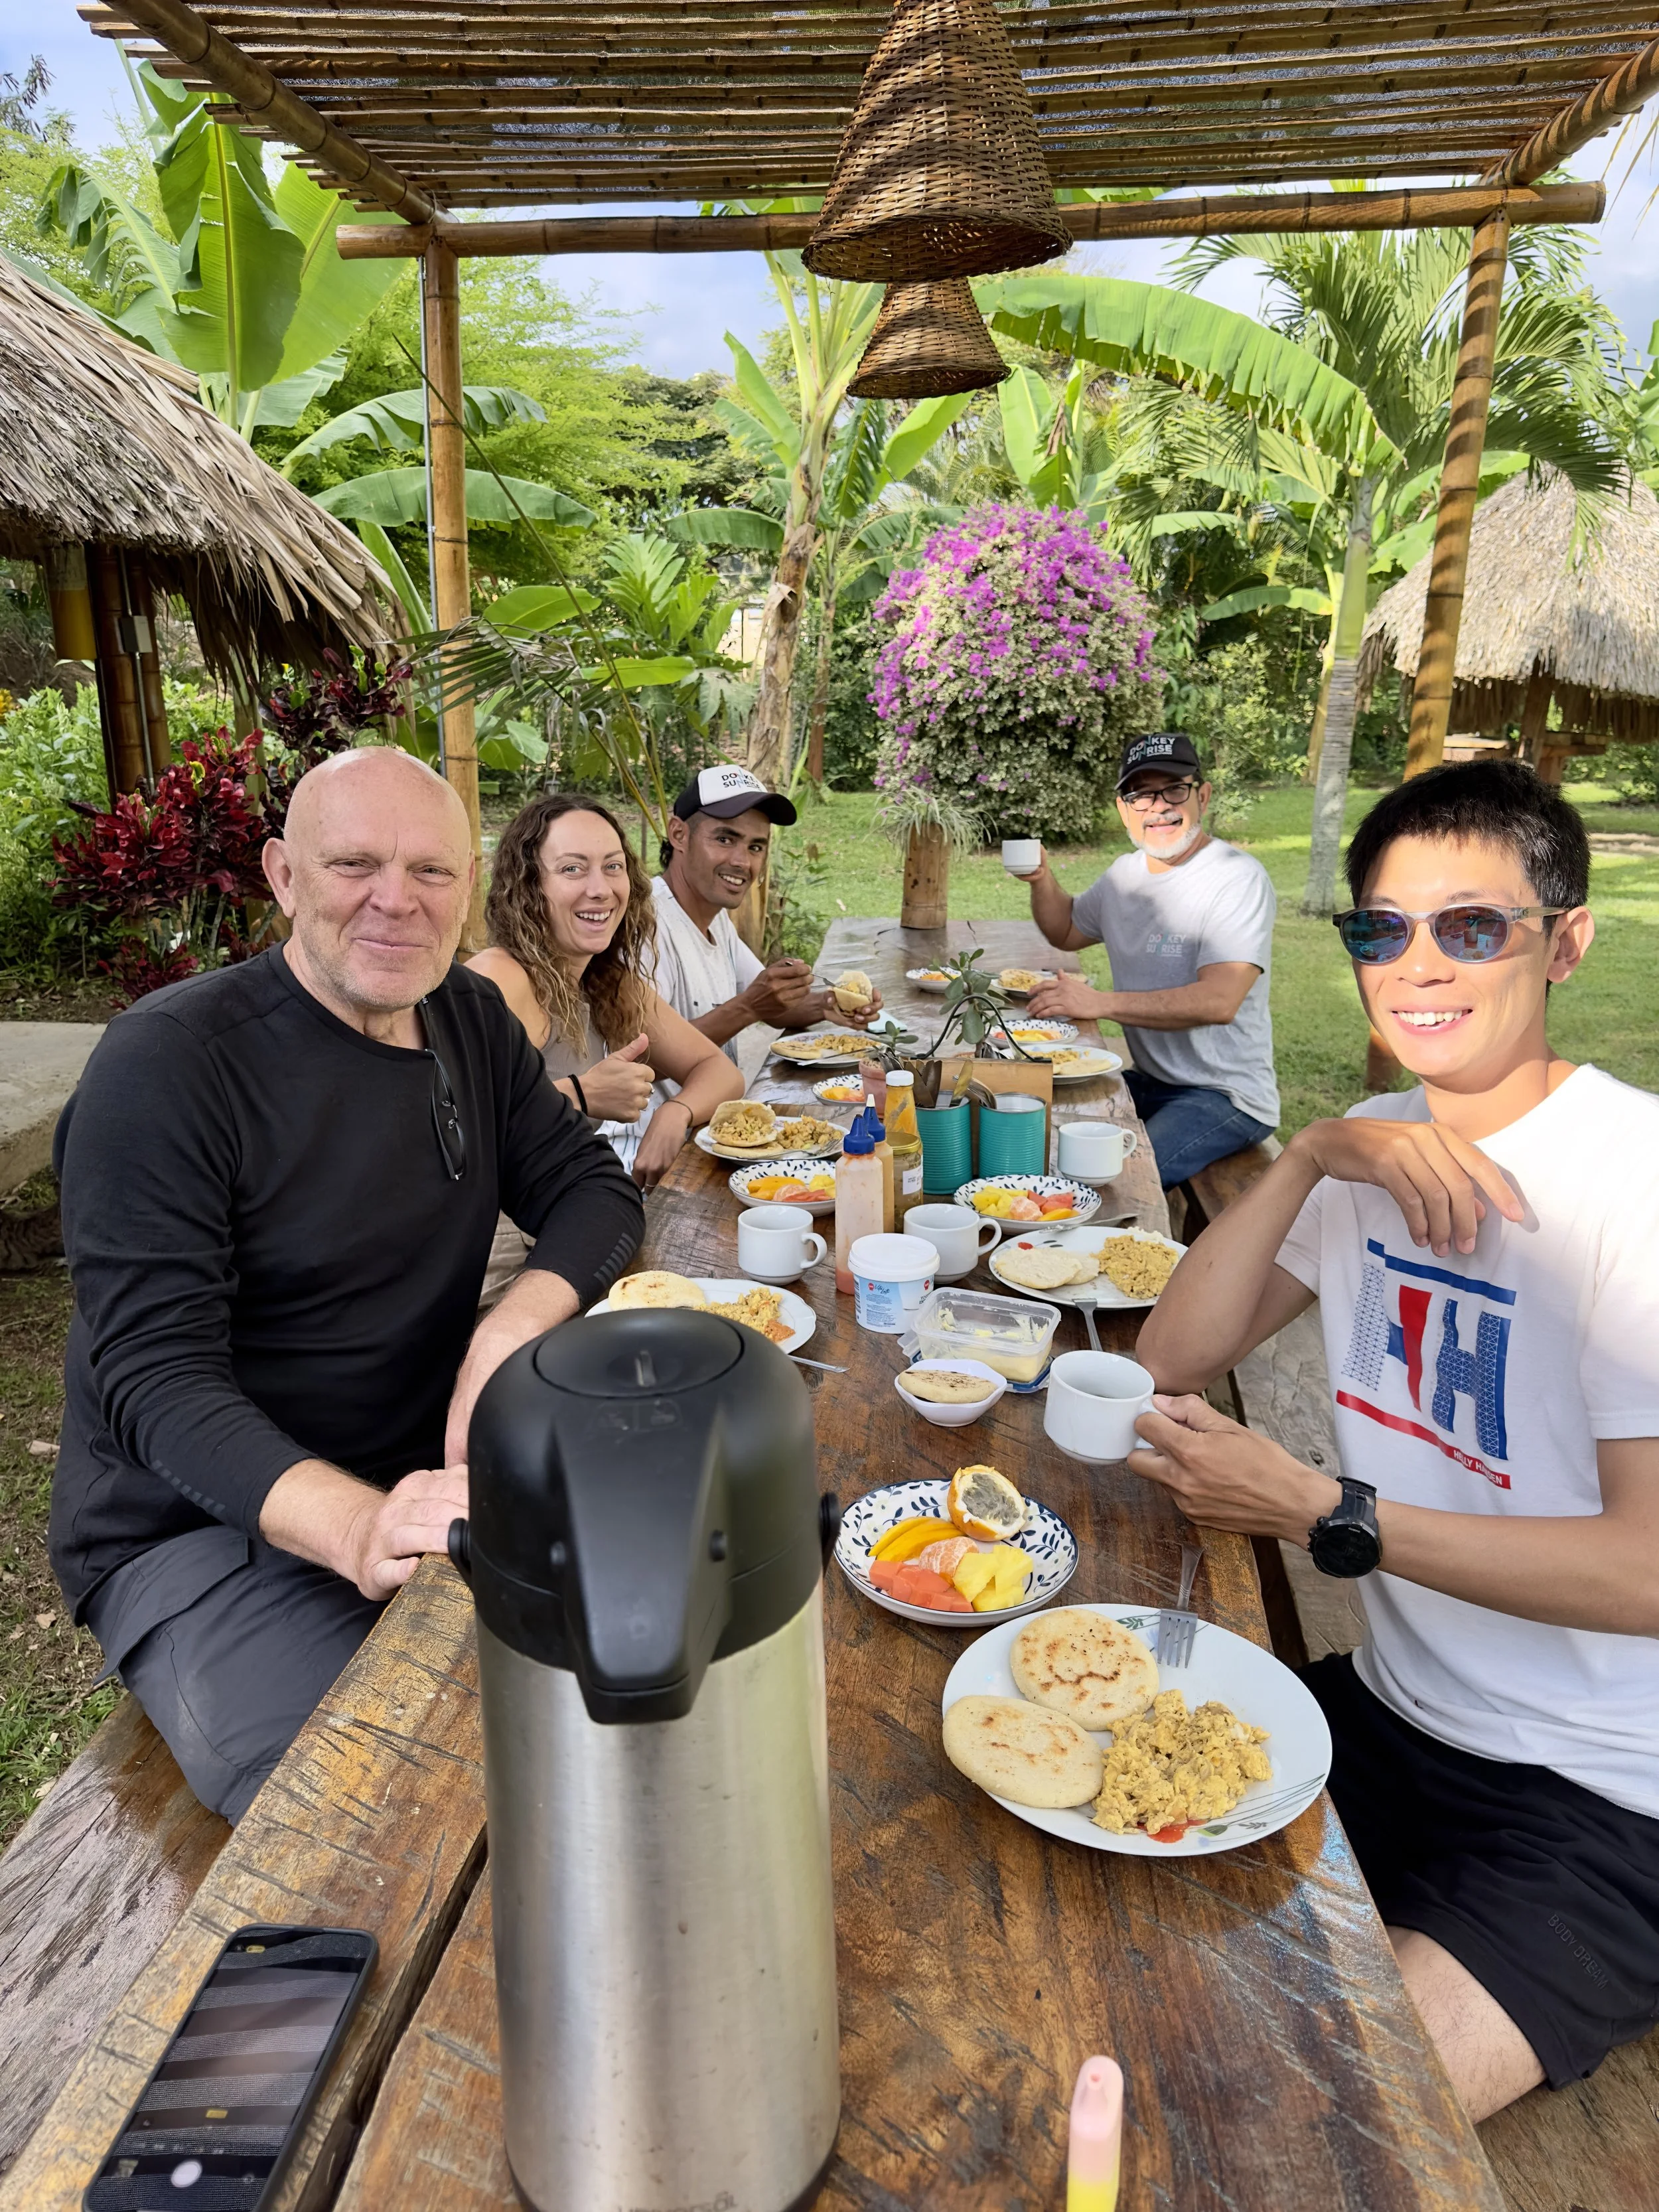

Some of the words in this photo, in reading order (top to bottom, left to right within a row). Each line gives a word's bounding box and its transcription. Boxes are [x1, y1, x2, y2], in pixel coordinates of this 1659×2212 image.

[1453, 1449, 1473, 1467] HELLY
[1548, 1914, 1577, 1947] BODY
[1573, 1945, 1609, 1990] DREAM
